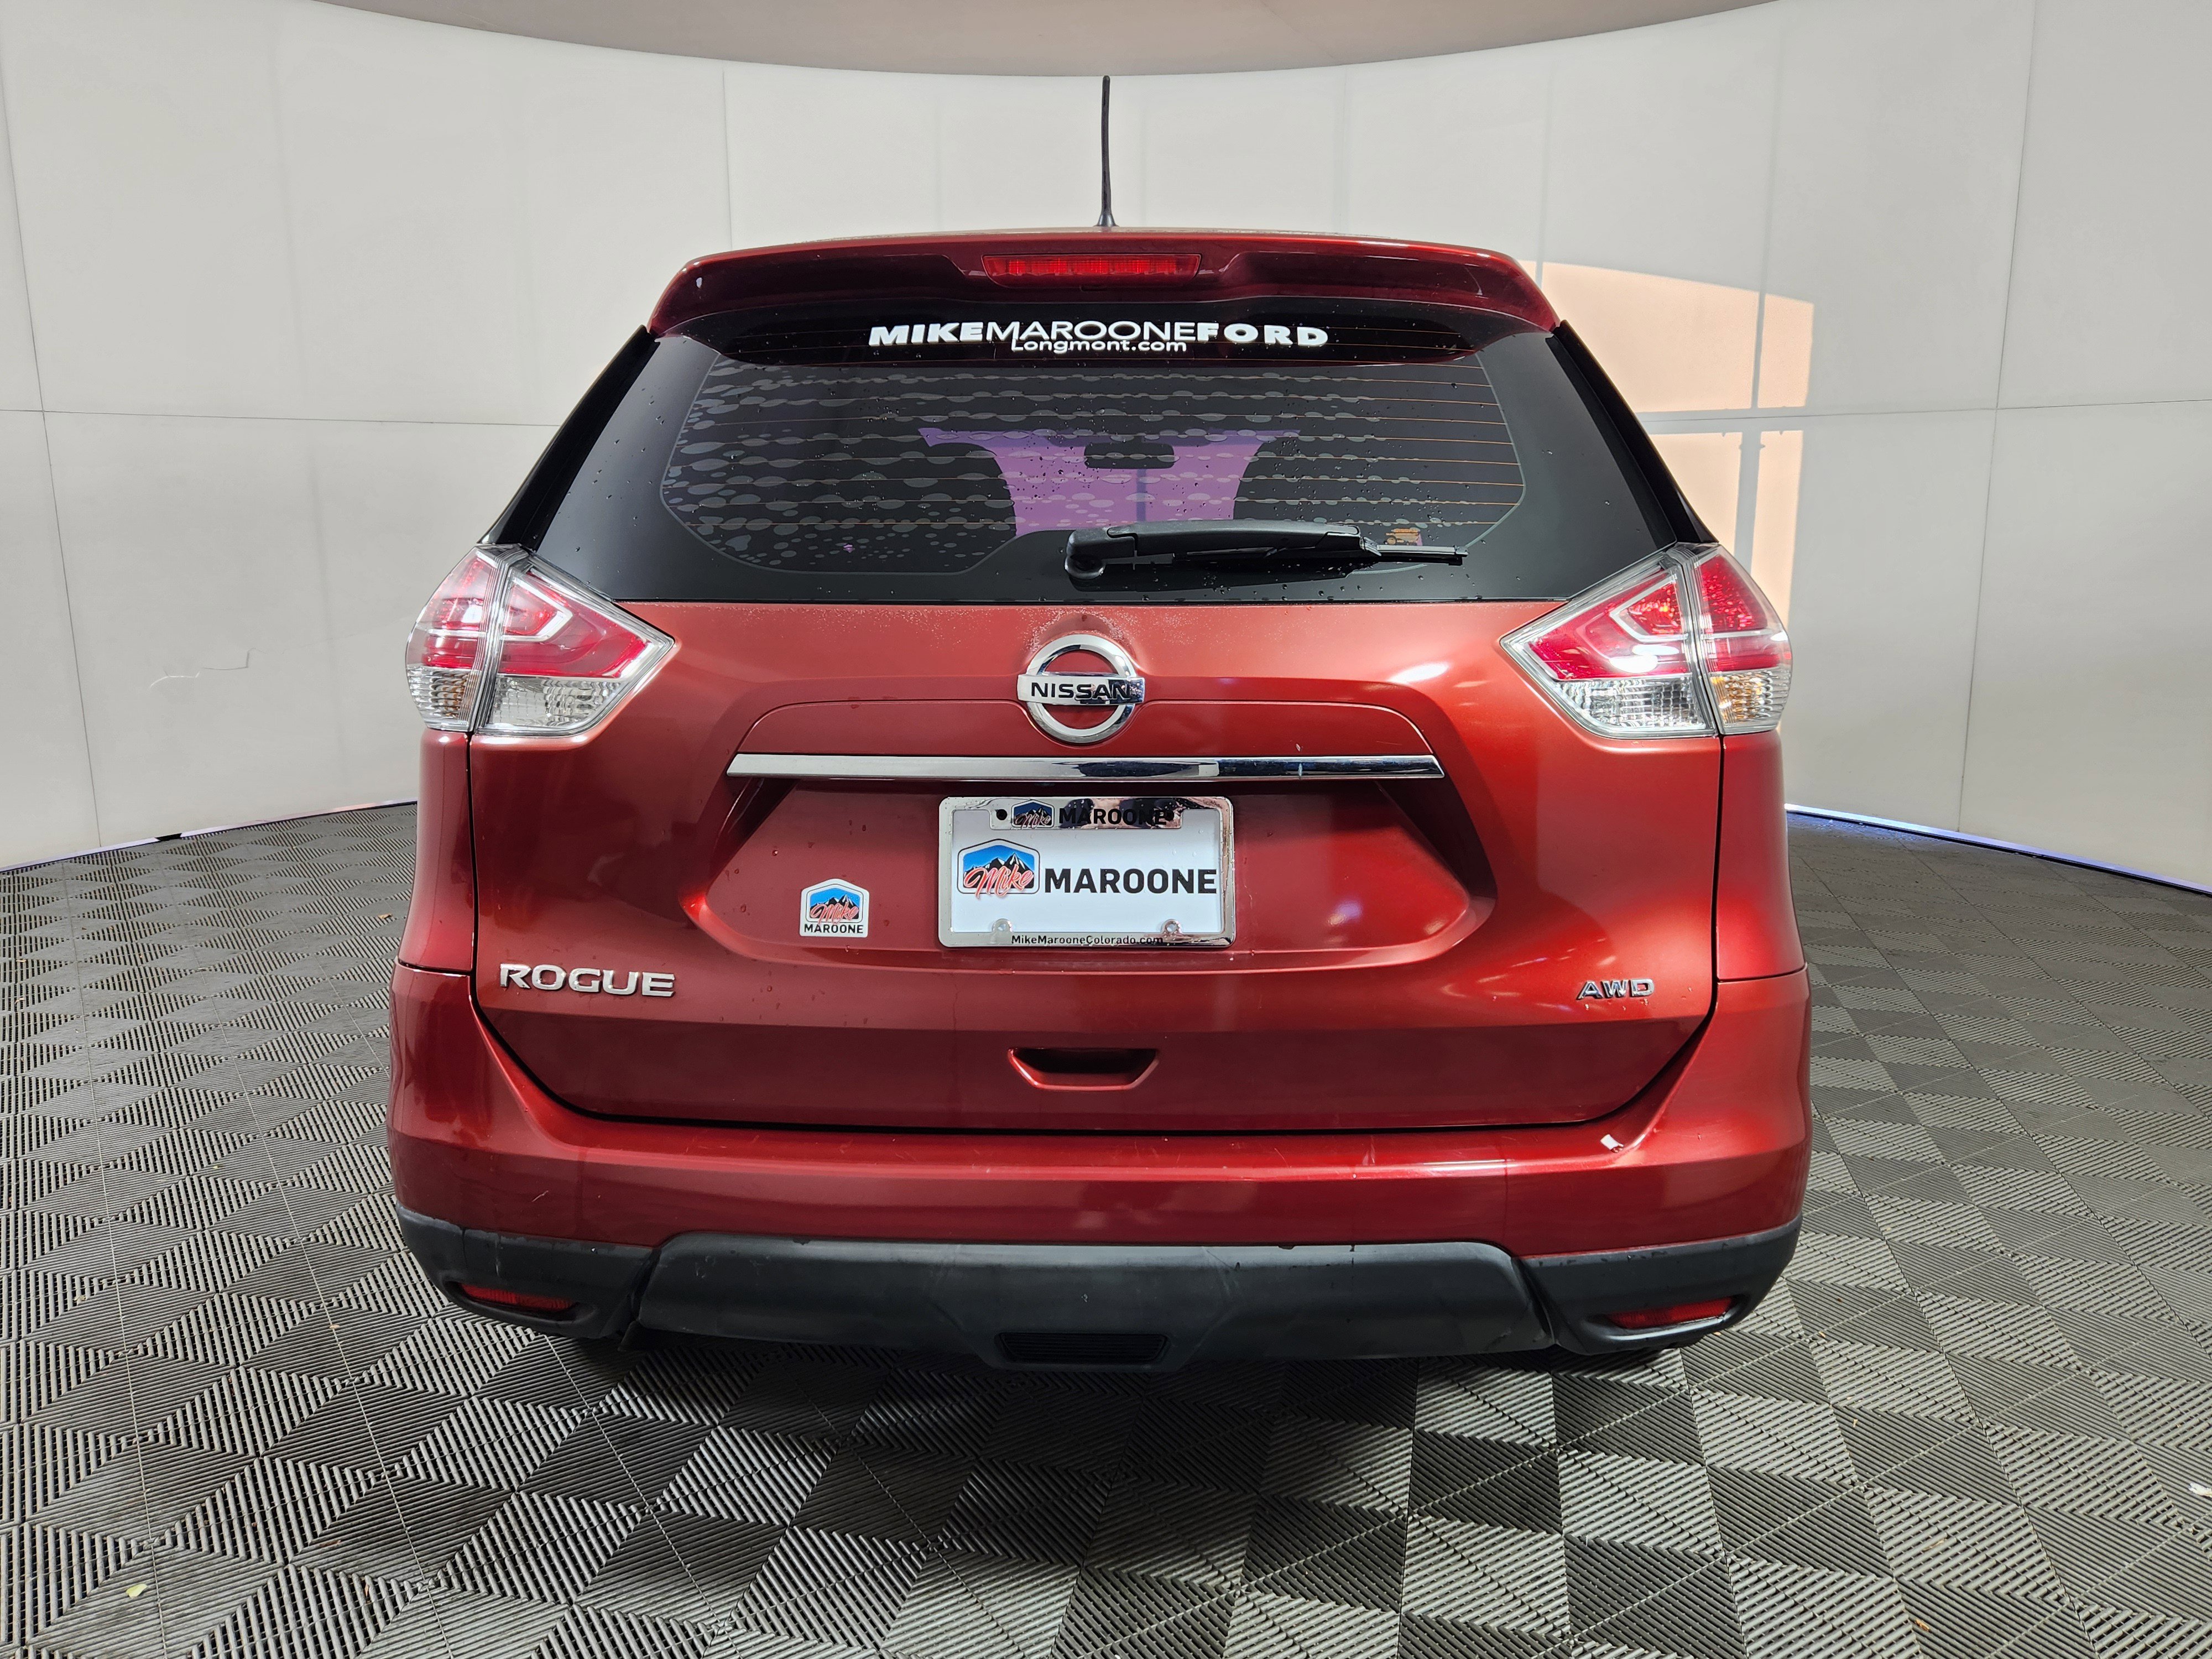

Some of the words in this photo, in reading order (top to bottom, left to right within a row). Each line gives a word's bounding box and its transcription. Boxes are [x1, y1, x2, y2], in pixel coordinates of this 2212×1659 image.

[1011, 338, 1187, 354] Longmont.com
[1031, 682, 1130, 700] NISSAN
[1014, 813, 1051, 829] Mike
[1058, 808, 1167, 826] MAROONE
[963, 864, 1034, 900] Mike
[1045, 868, 1217, 894] MAROONE
[810, 901, 859, 925] Mike
[804, 924, 863, 933] MAROONE
[1011, 935, 1164, 945] MikeMarooneColorado.com
[500, 963, 675, 997] ROGUE
[1576, 978, 1655, 1000] AWD
